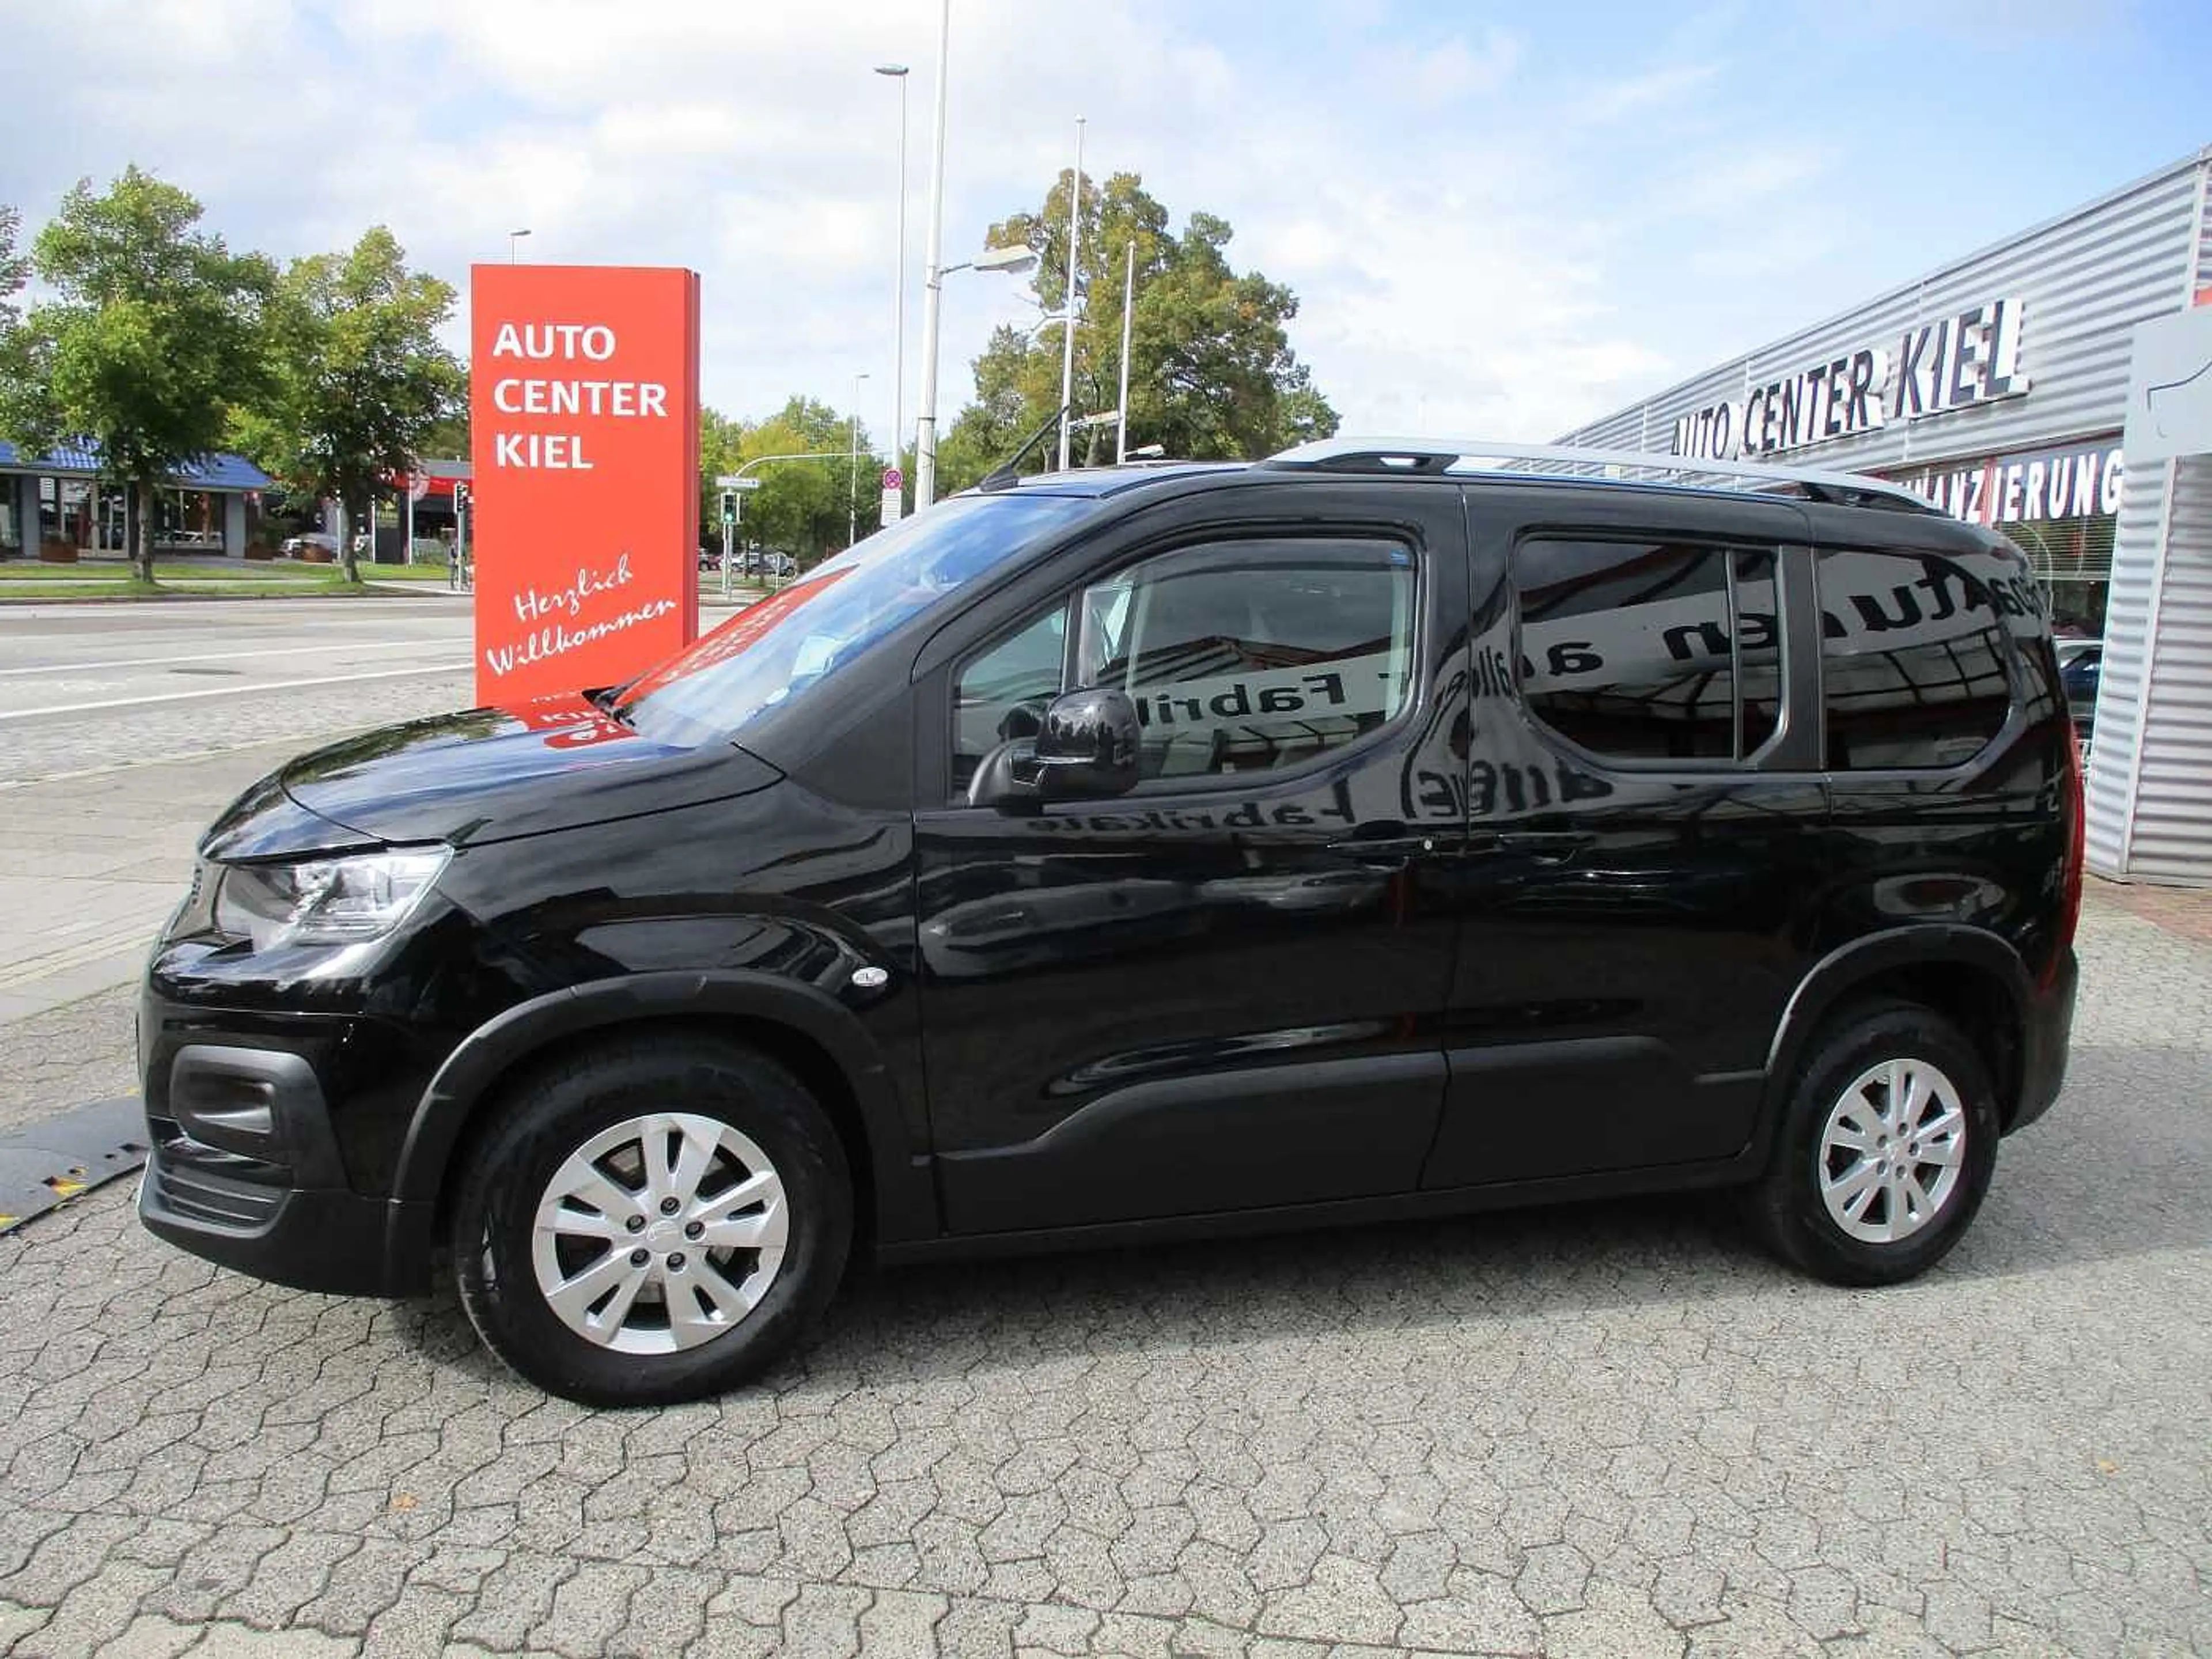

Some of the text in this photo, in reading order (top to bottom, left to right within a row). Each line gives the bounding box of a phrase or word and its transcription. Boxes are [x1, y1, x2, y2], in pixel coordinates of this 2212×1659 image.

[493, 323, 617, 361] AUTO
[493, 378, 668, 417] CENTER
[1671, 297, 2032, 460] AUTO CENTER KIEL
[496, 433, 593, 469] KIEL
[514, 553, 632, 623] Herzlich
[487, 598, 676, 677] Willkommen
